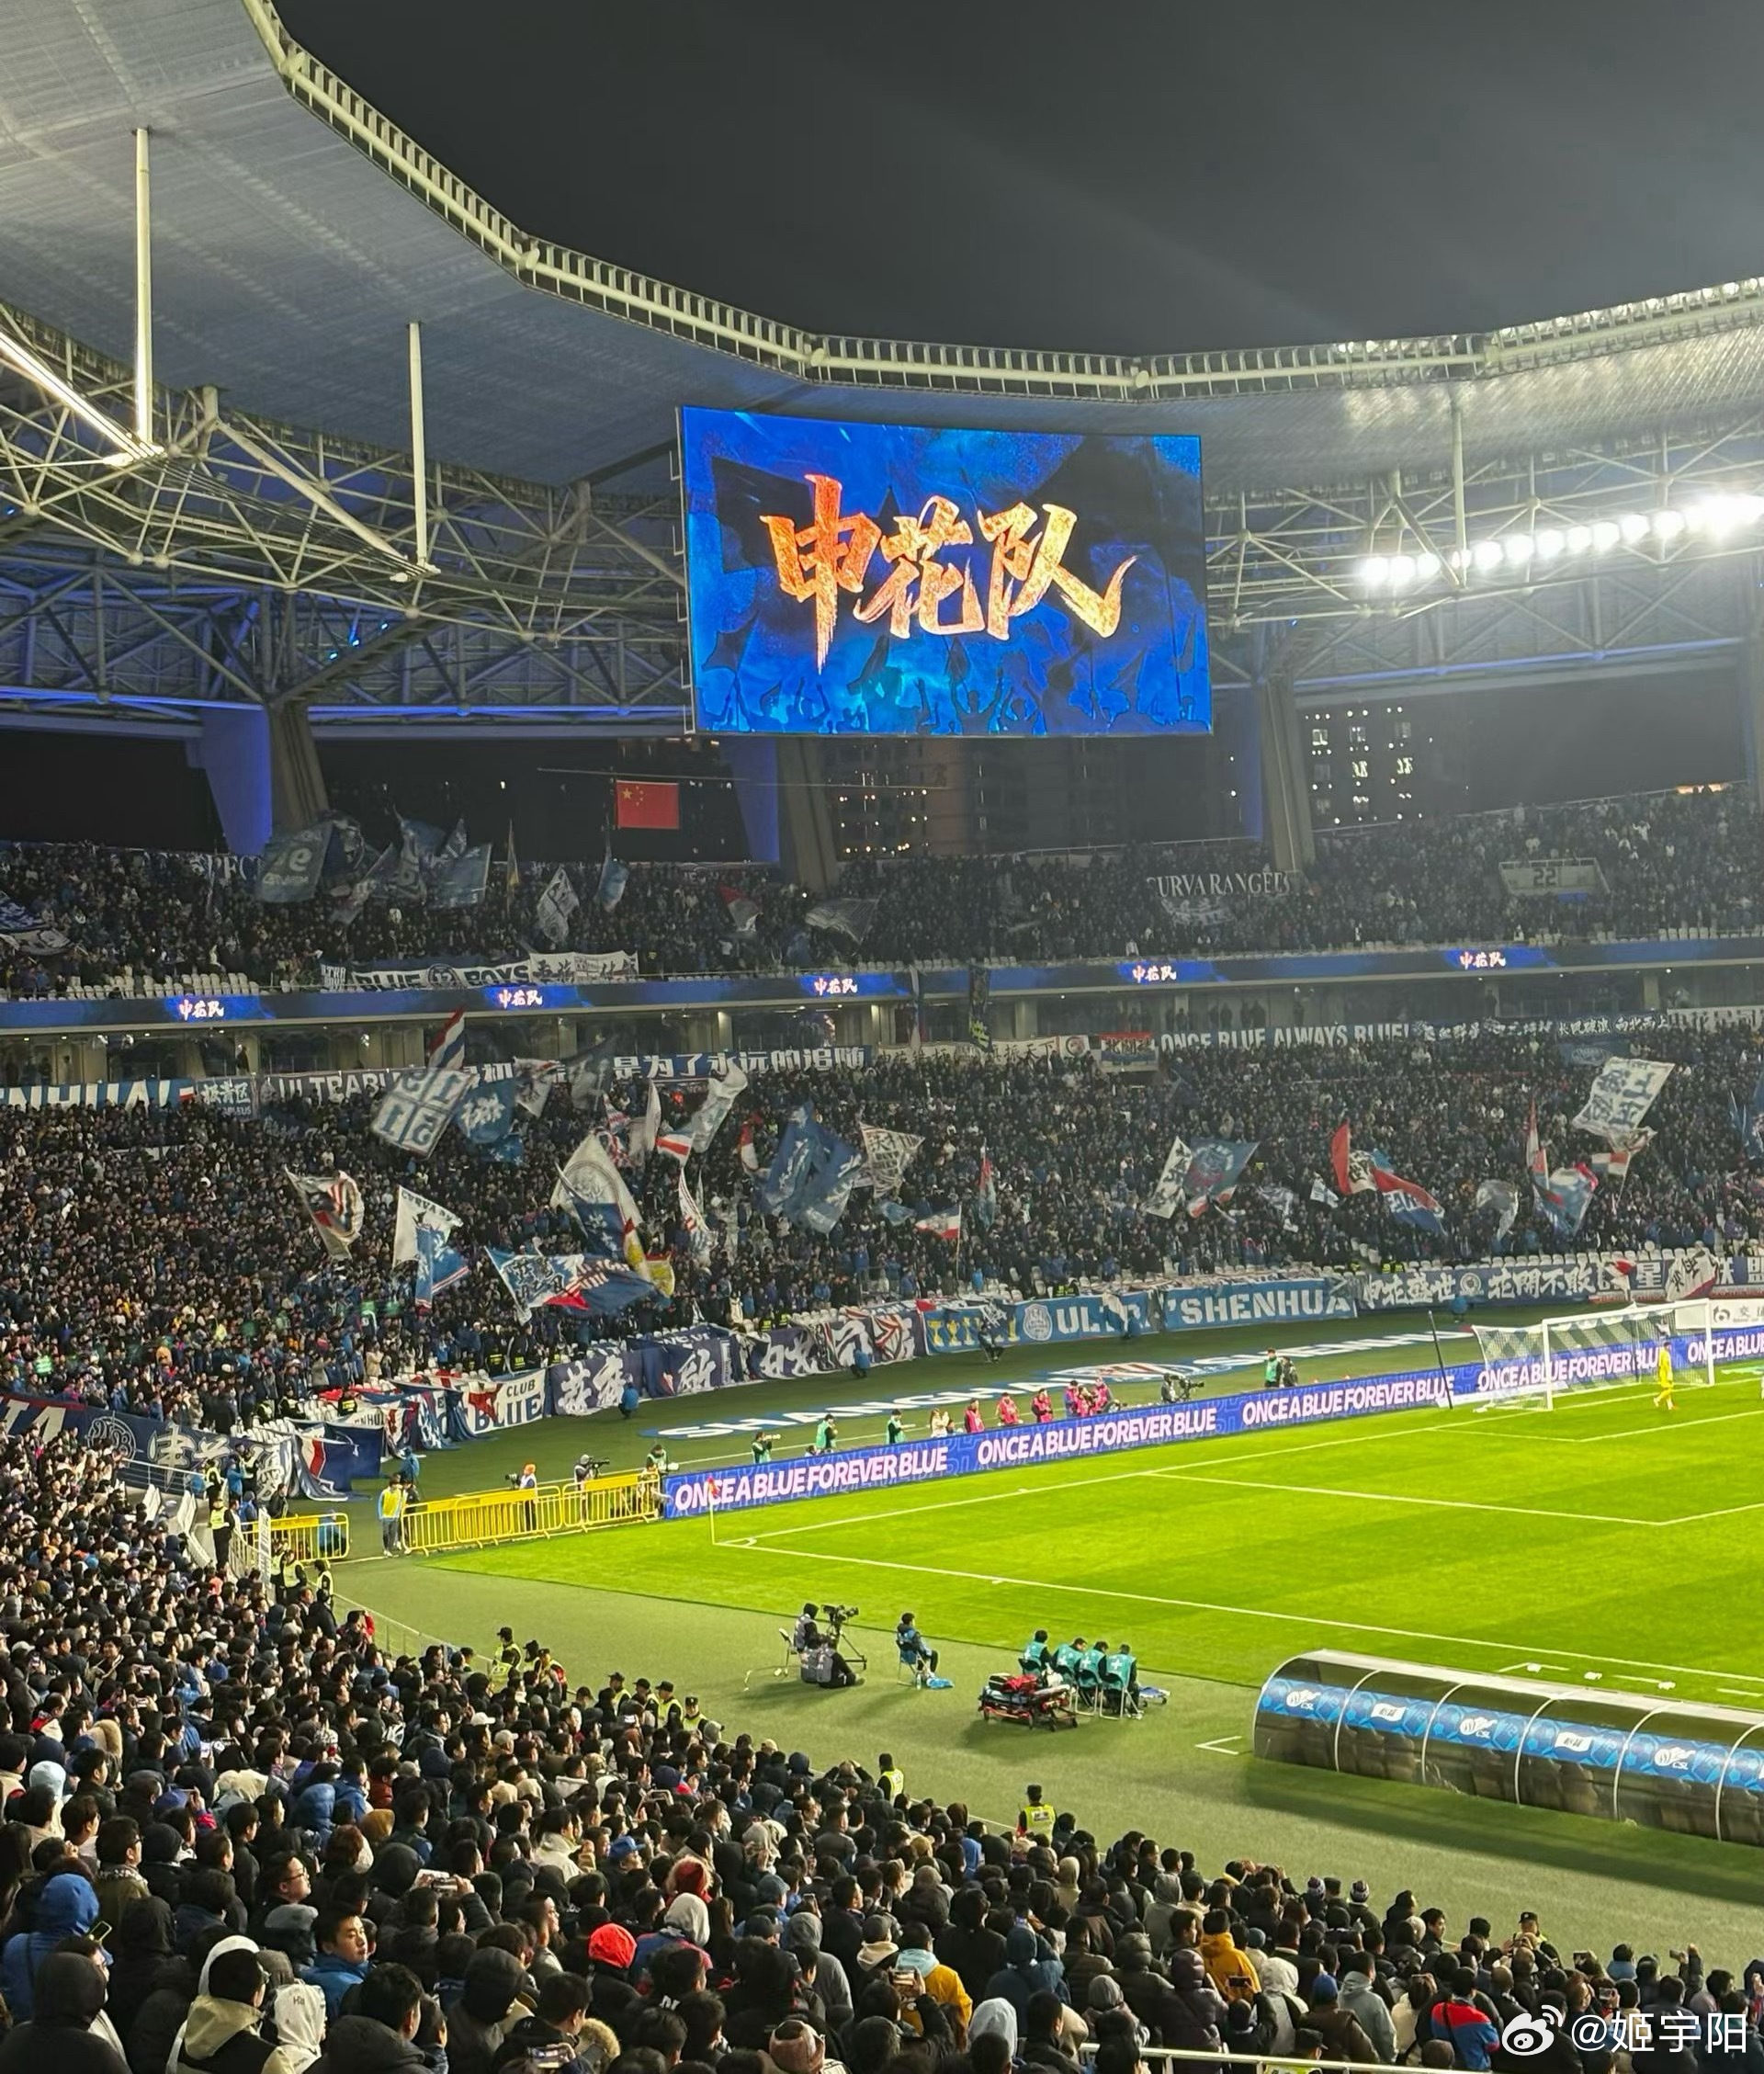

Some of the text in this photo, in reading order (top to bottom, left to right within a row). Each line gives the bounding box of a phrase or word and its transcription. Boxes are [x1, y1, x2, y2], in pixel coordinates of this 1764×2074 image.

[759, 473, 1139, 675] 申花队
[1532, 867, 1556, 886] 22
[356, 973, 422, 992] BLUE
[463, 962, 530, 987] BOYS
[1160, 1032, 1212, 1053] ONCE
[1218, 1027, 1266, 1051] BLUE
[1273, 1025, 1348, 1049] ALWAYS
[1688, 1338, 1726, 1363] ONCE
[1724, 1337, 1736, 1357] A
[1477, 1366, 1521, 1392] ONCE
[1519, 1365, 1533, 1387] A
[1569, 1352, 1632, 1379] FOREVER
[506, 1379, 536, 1398] CLUB
[1242, 1375, 1455, 1425] ONCE A BLUE FOREVER BLUE
[978, 1407, 1217, 1466] ONCE A BLUE FOREVER BLUE
[674, 1446, 948, 1511] ONCE A BLUE FOREVER BLUE
[1300, 1701, 1314, 1711] CSL
[1476, 1729, 1490, 1740] CSL
[1672, 1762, 1689, 1771] CSL
